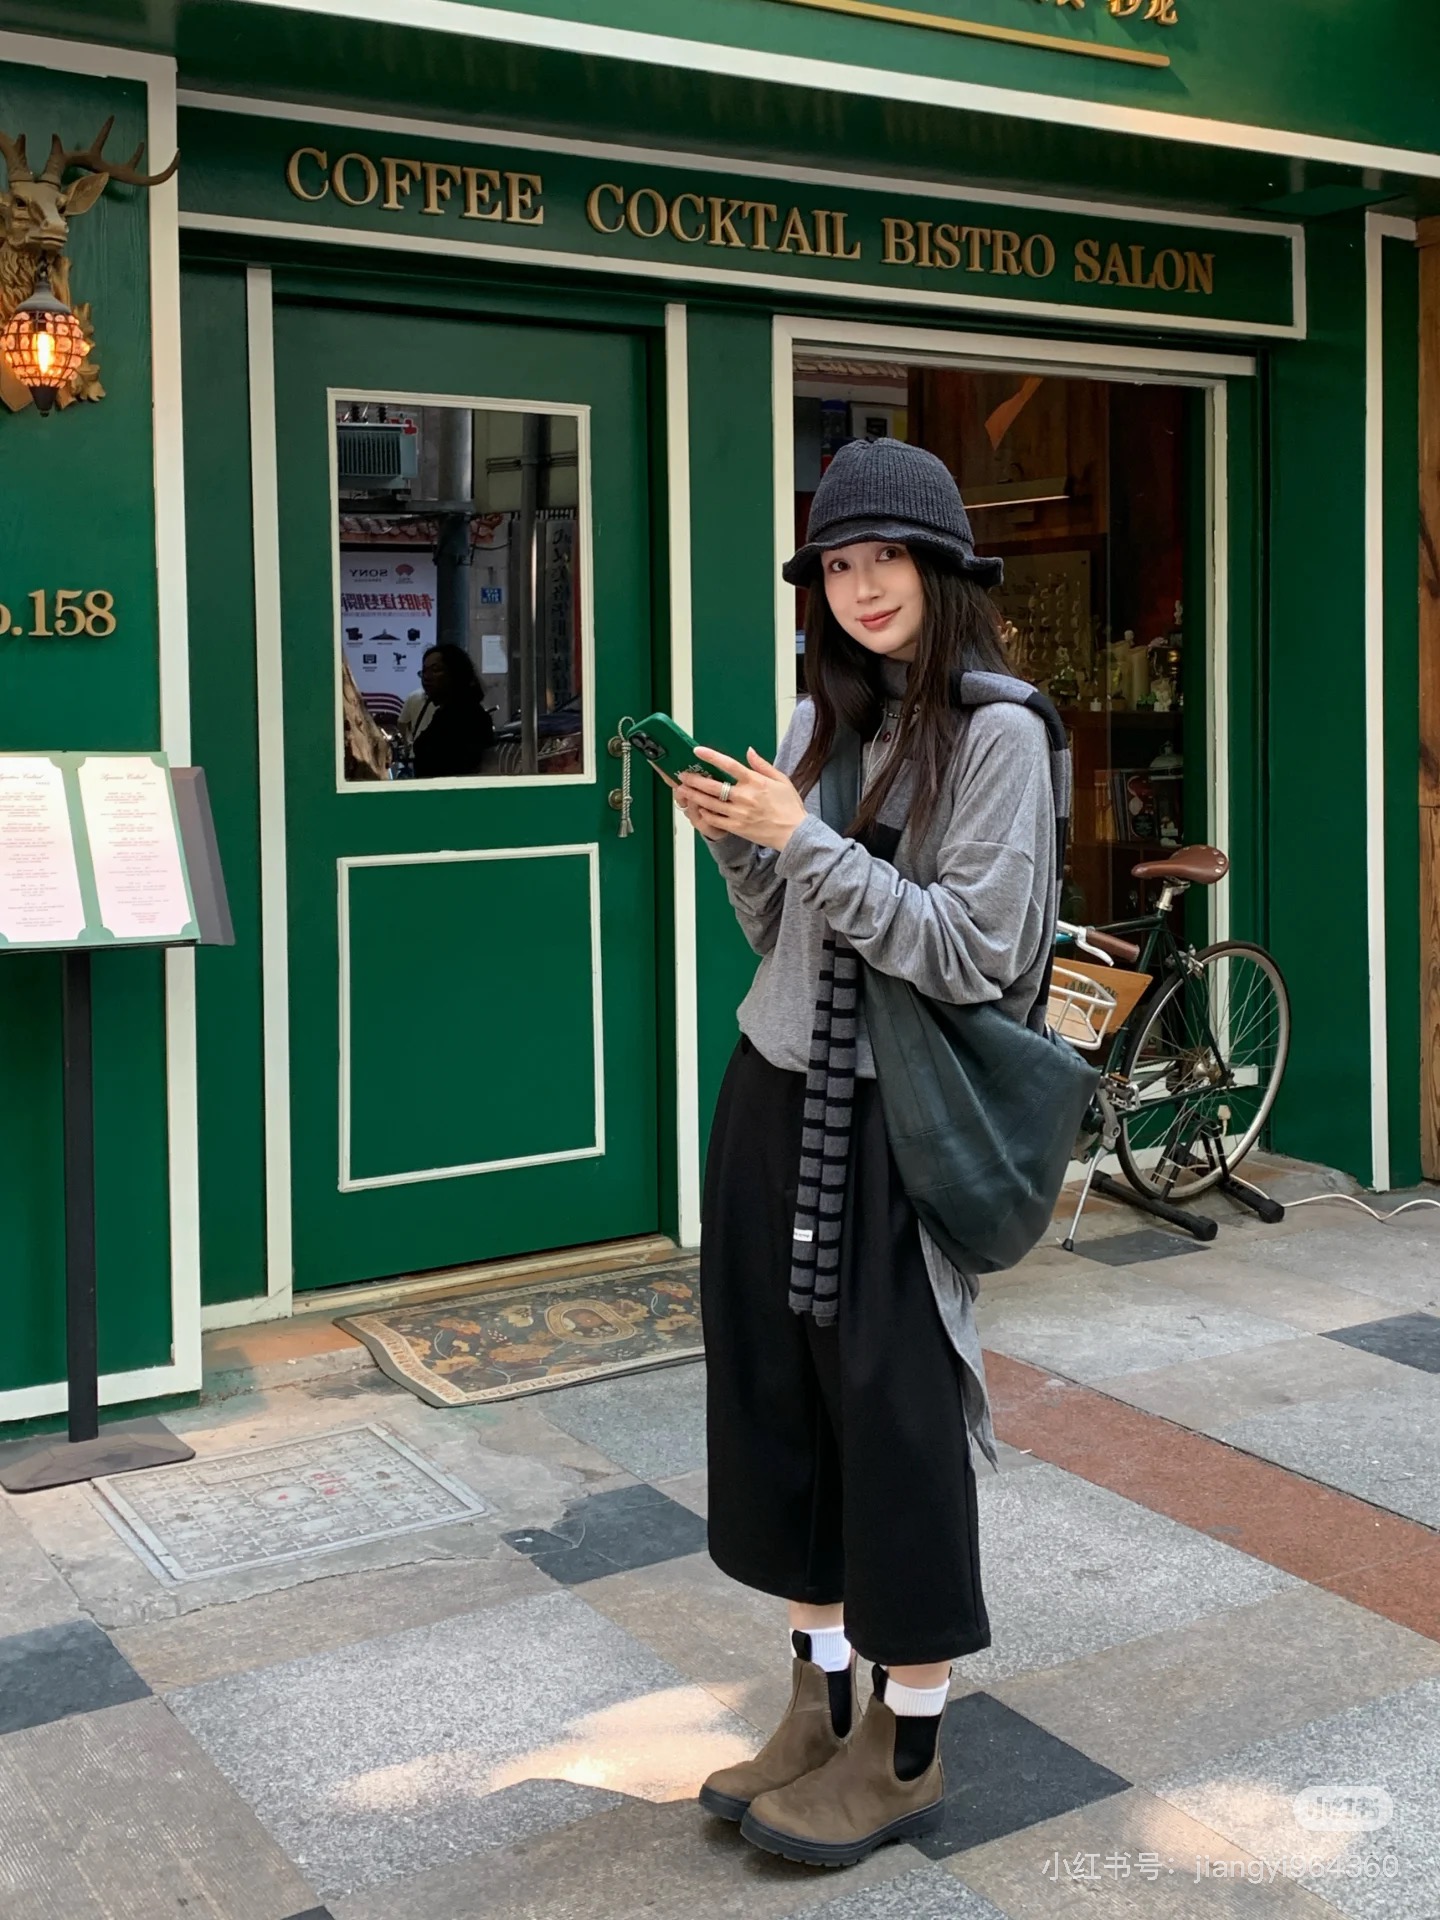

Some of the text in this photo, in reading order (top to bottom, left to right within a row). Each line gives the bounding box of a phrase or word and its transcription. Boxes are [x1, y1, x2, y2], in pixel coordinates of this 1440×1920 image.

[286, 147, 1215, 294] COFFEE COCKTAIL BISTRO SALON
